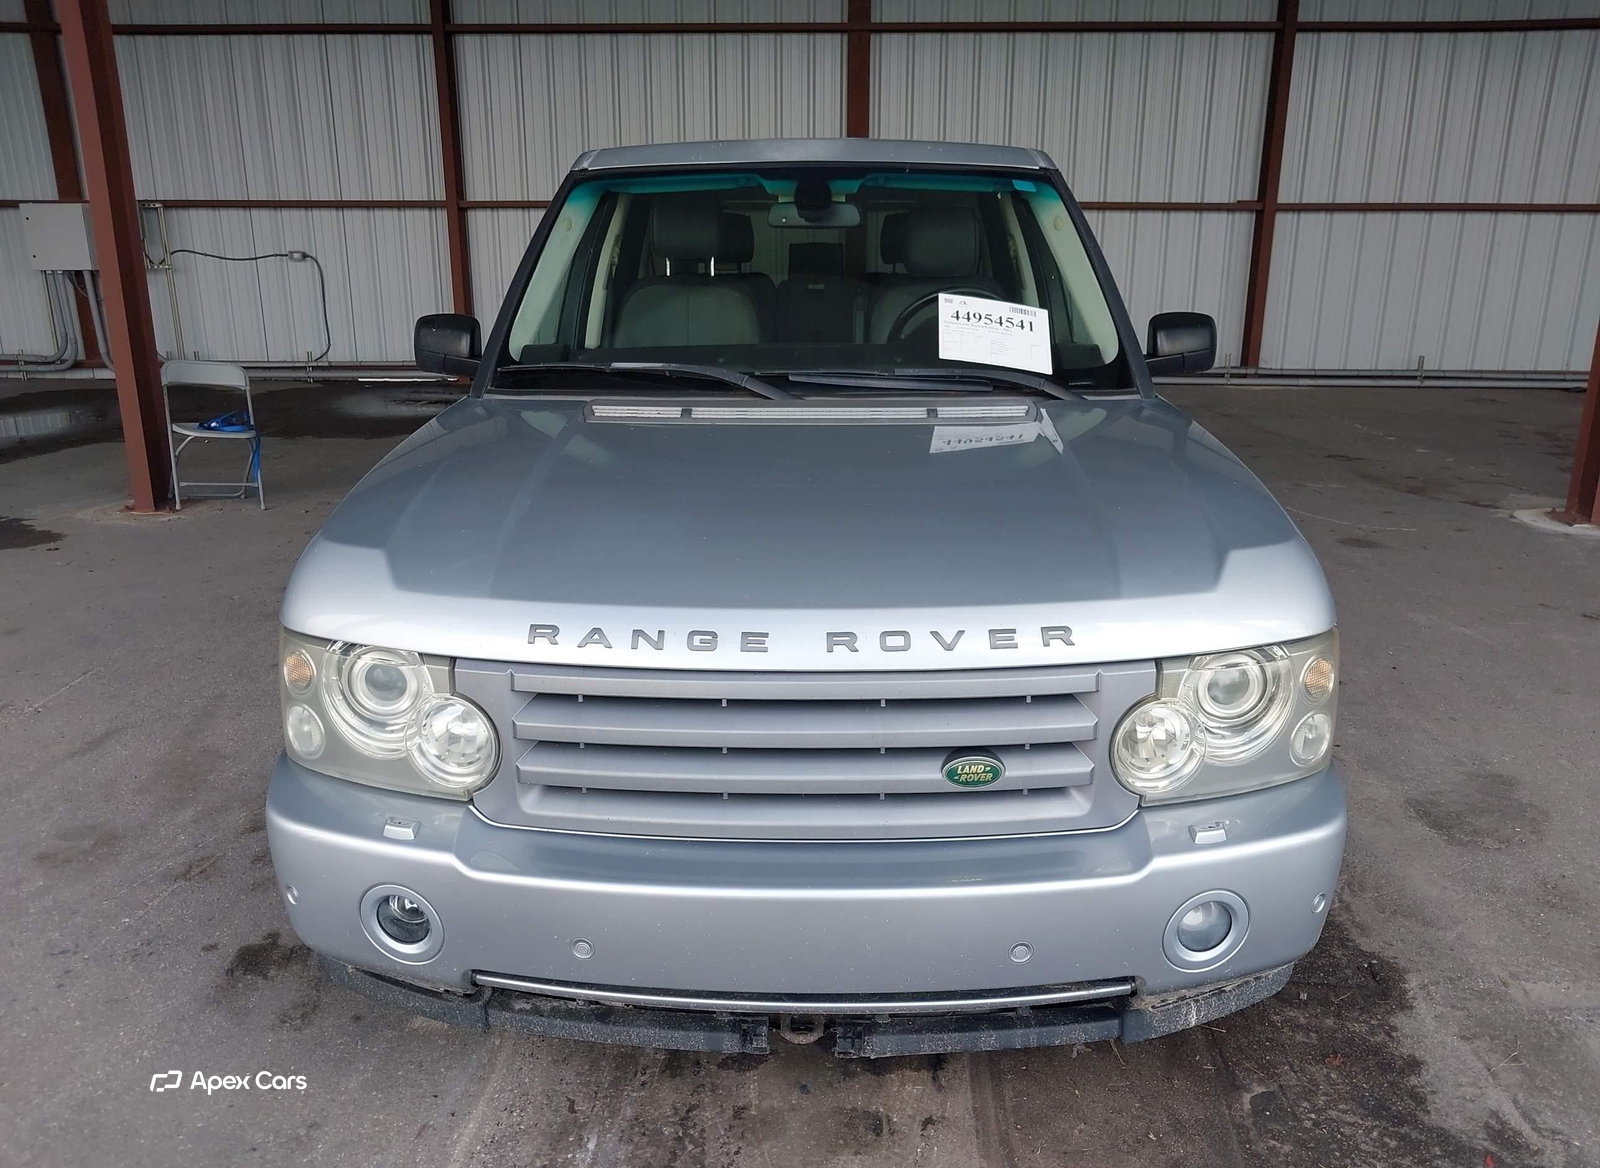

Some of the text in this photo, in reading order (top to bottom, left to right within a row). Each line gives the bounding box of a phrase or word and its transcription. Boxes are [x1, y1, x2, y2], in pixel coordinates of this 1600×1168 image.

[950, 309, 1035, 333] 44954541
[527, 623, 1076, 653] RANGE ROVER
[957, 764, 985, 774] LAND
[959, 773, 993, 782] ROVER
